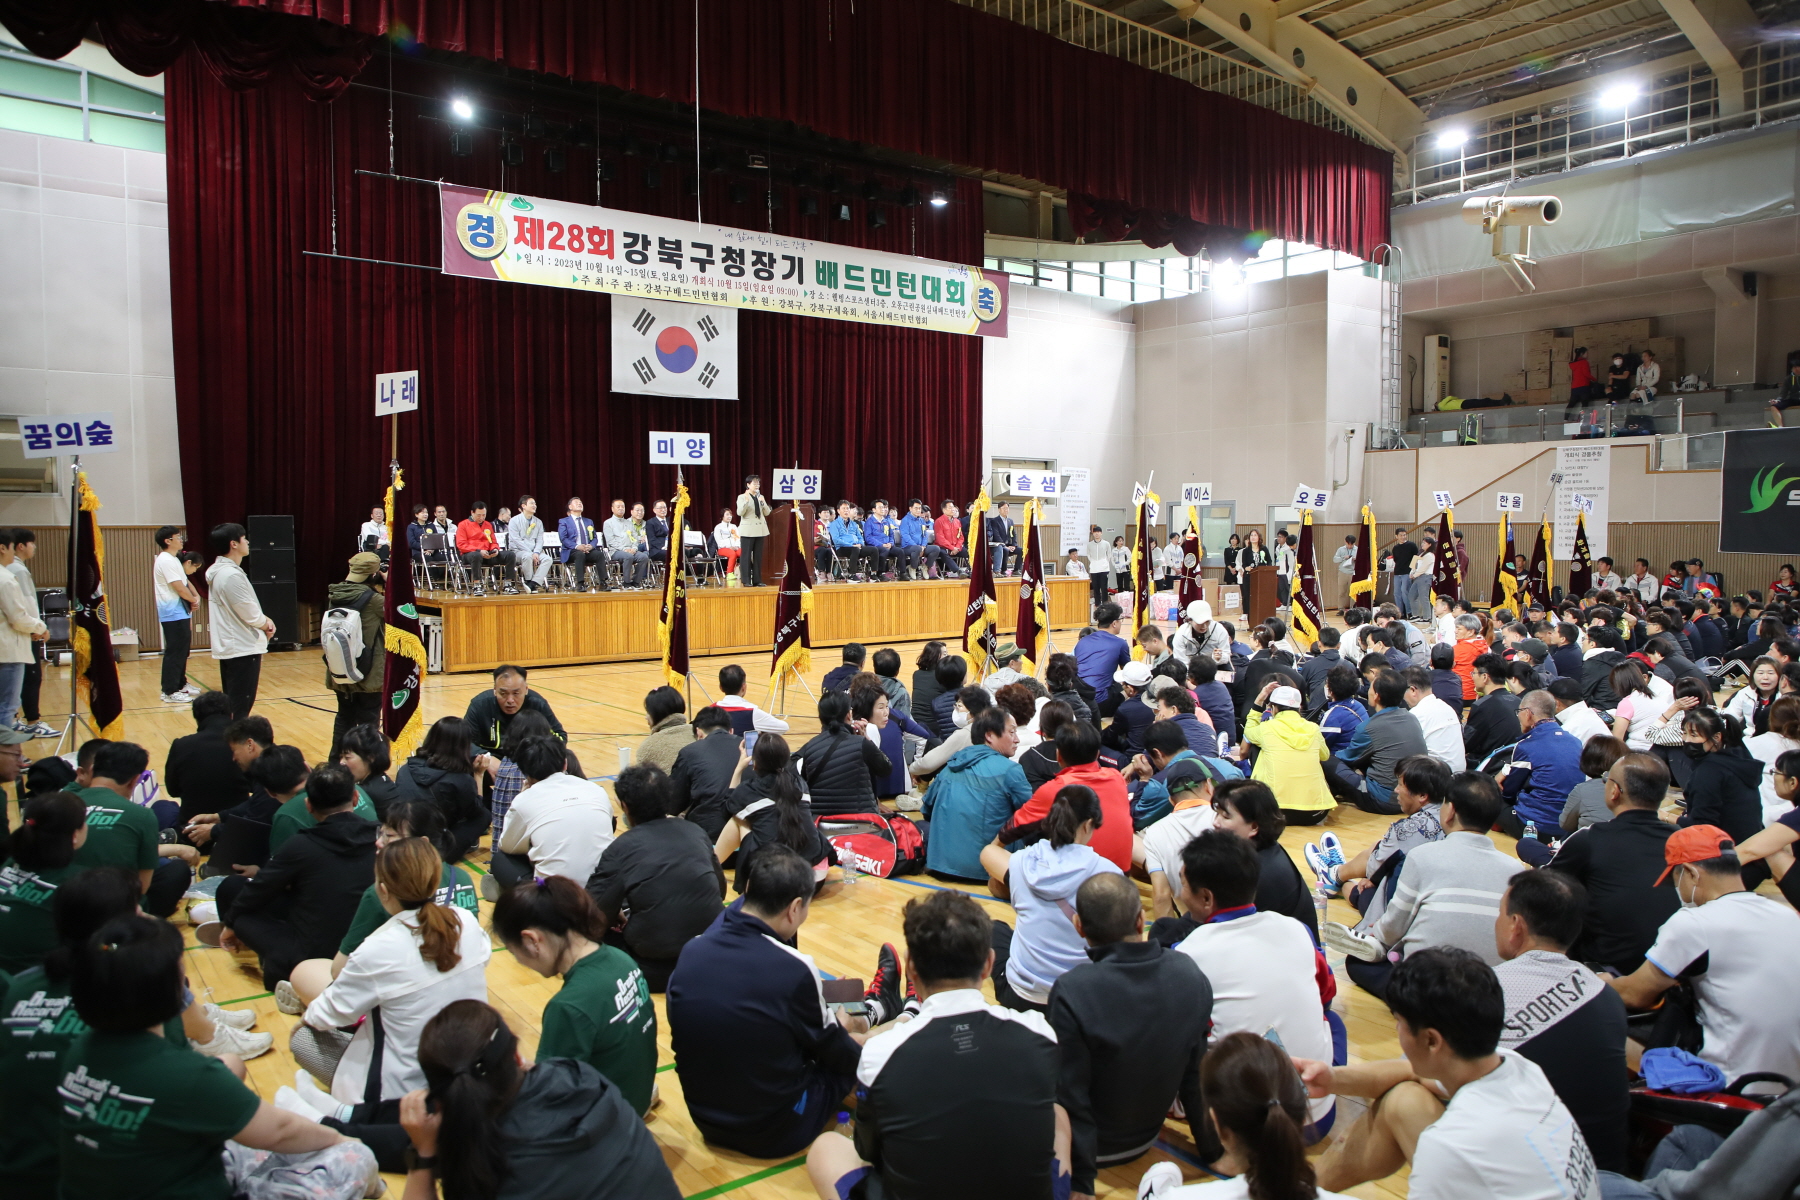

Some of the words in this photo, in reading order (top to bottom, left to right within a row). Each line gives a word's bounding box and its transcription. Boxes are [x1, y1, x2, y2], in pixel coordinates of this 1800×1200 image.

[467, 212, 495, 249] 경
[513, 215, 615, 260] 제28회
[622, 231, 804, 285] 강북구청장기
[815, 259, 966, 307] 배드민턴대회
[554, 257, 582, 271] 2023년
[585, 262, 603, 274] 10월
[691, 275, 714, 288] 개회식
[717, 279, 732, 290] 10월
[643, 283, 729, 303] 강북구배드민턴협회
[862, 310, 928, 326] 서울시배드민턴협회
[978, 287, 995, 314] 축
[23, 420, 114, 451] 꿈의숲
[1184, 486, 1210, 502] 에이스
[1503, 982, 1580, 1038] SPORTS
[96, 1098, 151, 1132] Go!
